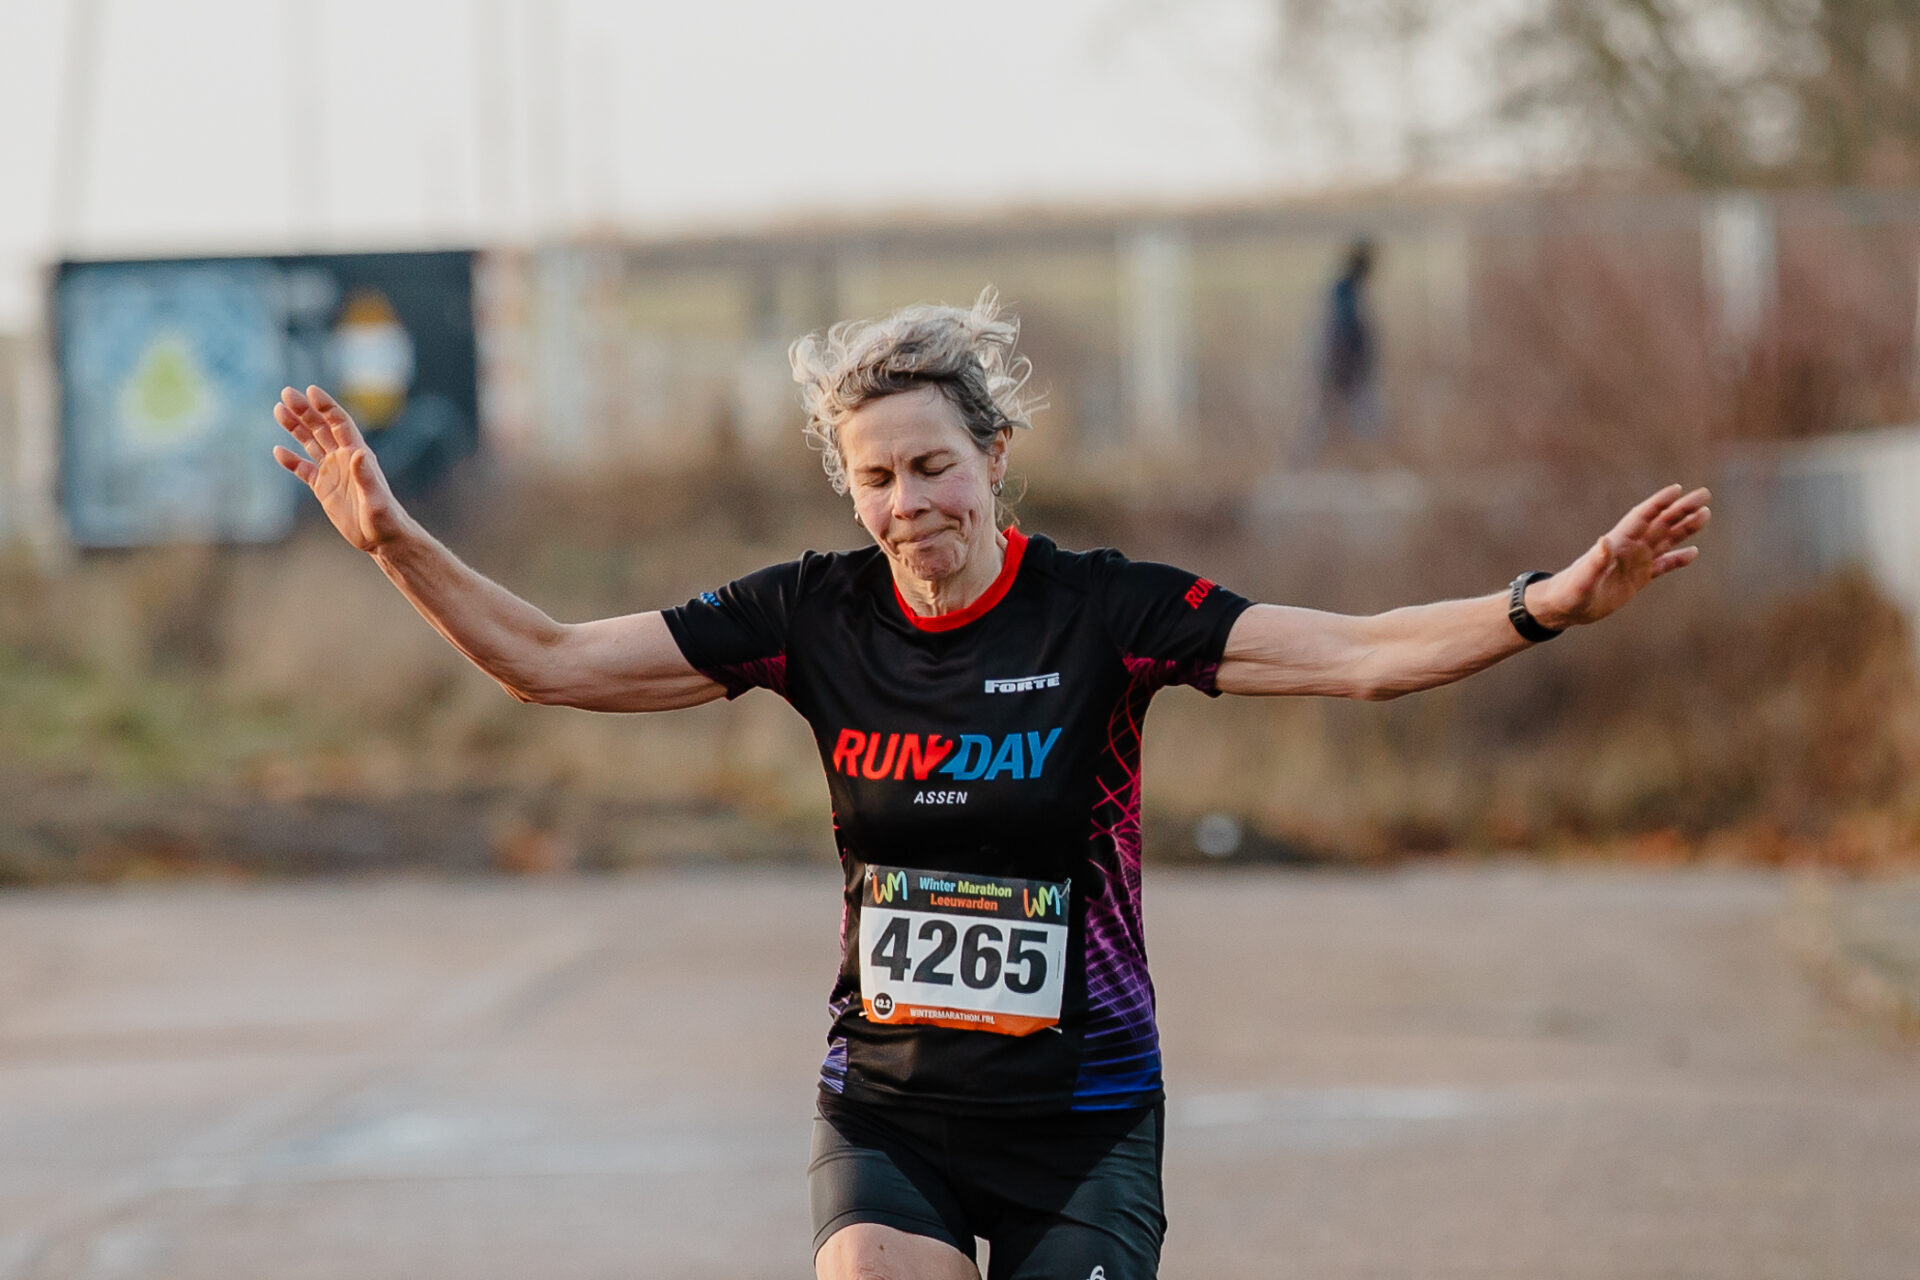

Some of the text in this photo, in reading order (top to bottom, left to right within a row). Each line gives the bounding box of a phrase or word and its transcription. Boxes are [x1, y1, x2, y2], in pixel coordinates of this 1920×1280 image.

[984, 672, 1060, 693] FORTE
[914, 791, 968, 804] ASSEN
[919, 877, 1012, 898] Winter Marathon
[930, 894, 998, 911] Leeuwarden
[871, 917, 1048, 994] 4265
[910, 1009, 995, 1025] WINTERMARATHON.FRL
